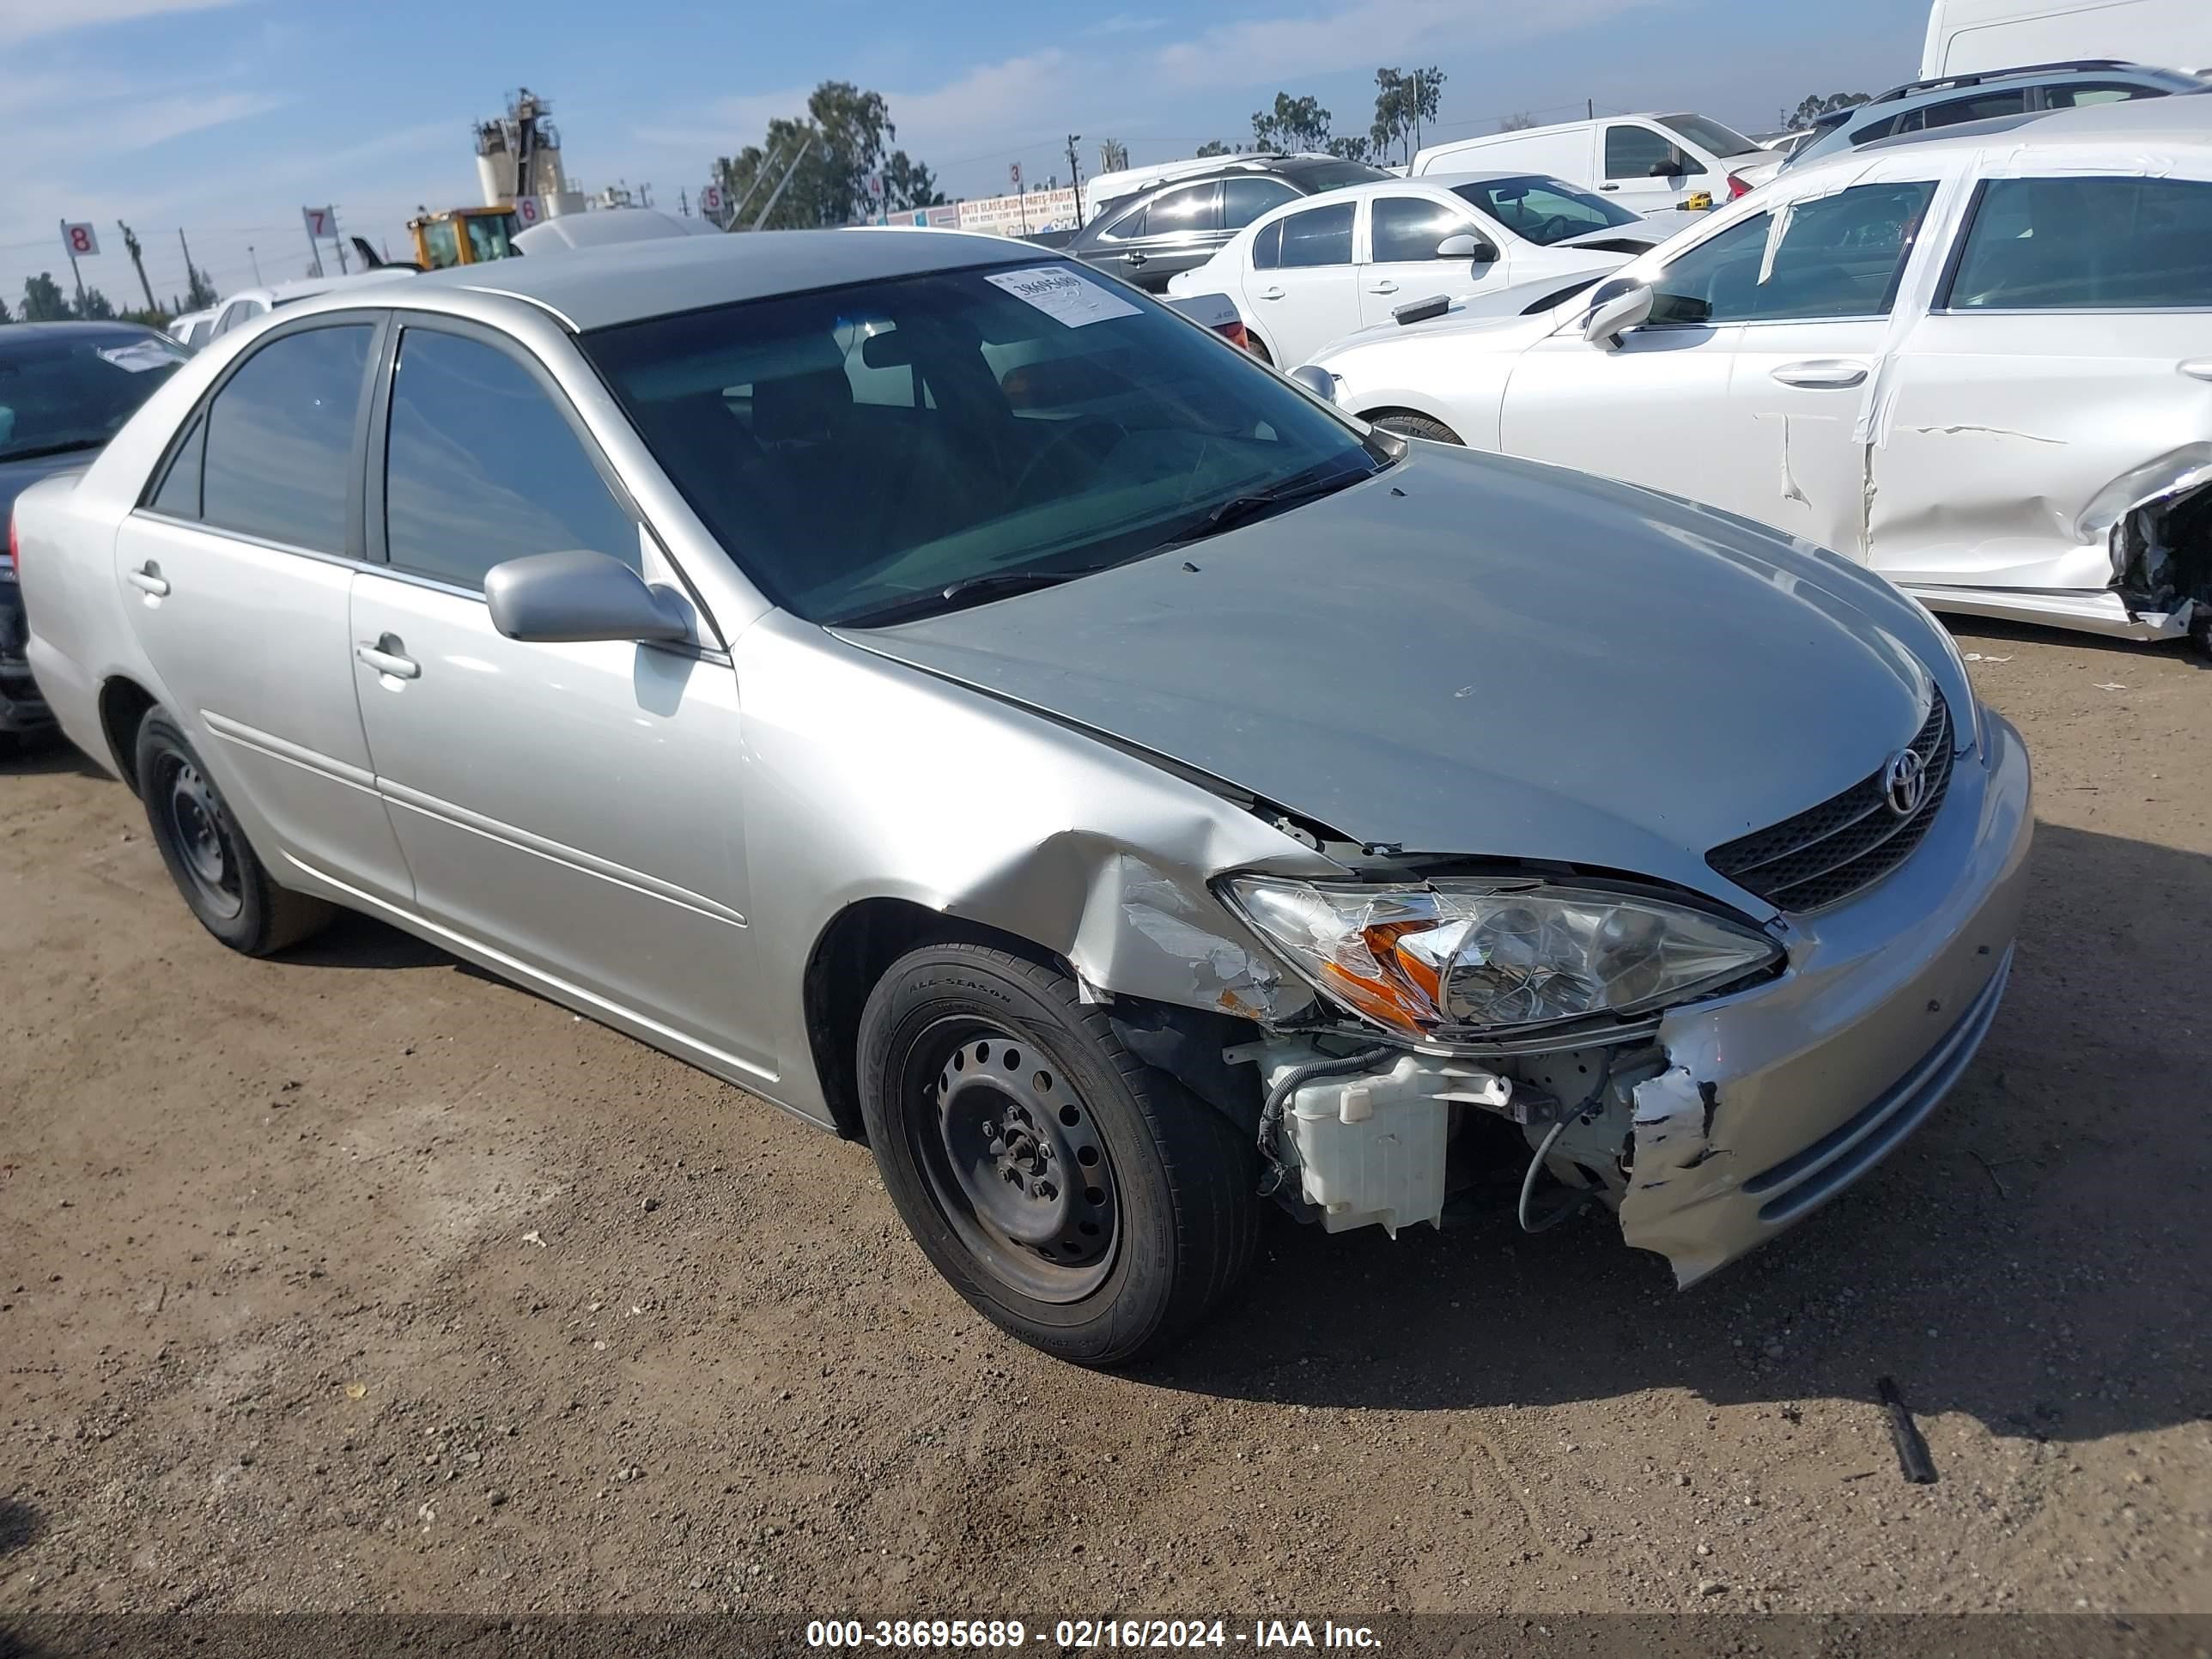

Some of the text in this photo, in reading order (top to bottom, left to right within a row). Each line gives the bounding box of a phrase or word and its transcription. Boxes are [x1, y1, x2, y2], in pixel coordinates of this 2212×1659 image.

[1012, 165, 1019, 182] 3
[872, 178, 880, 194] 4
[708, 188, 720, 207] 5
[523, 200, 536, 221] 6
[309, 212, 325, 234] 7
[70, 228, 91, 251] 8
[1013, 275, 1082, 296] 38695689
[909, 977, 1012, 1003] ALL-SEASON
